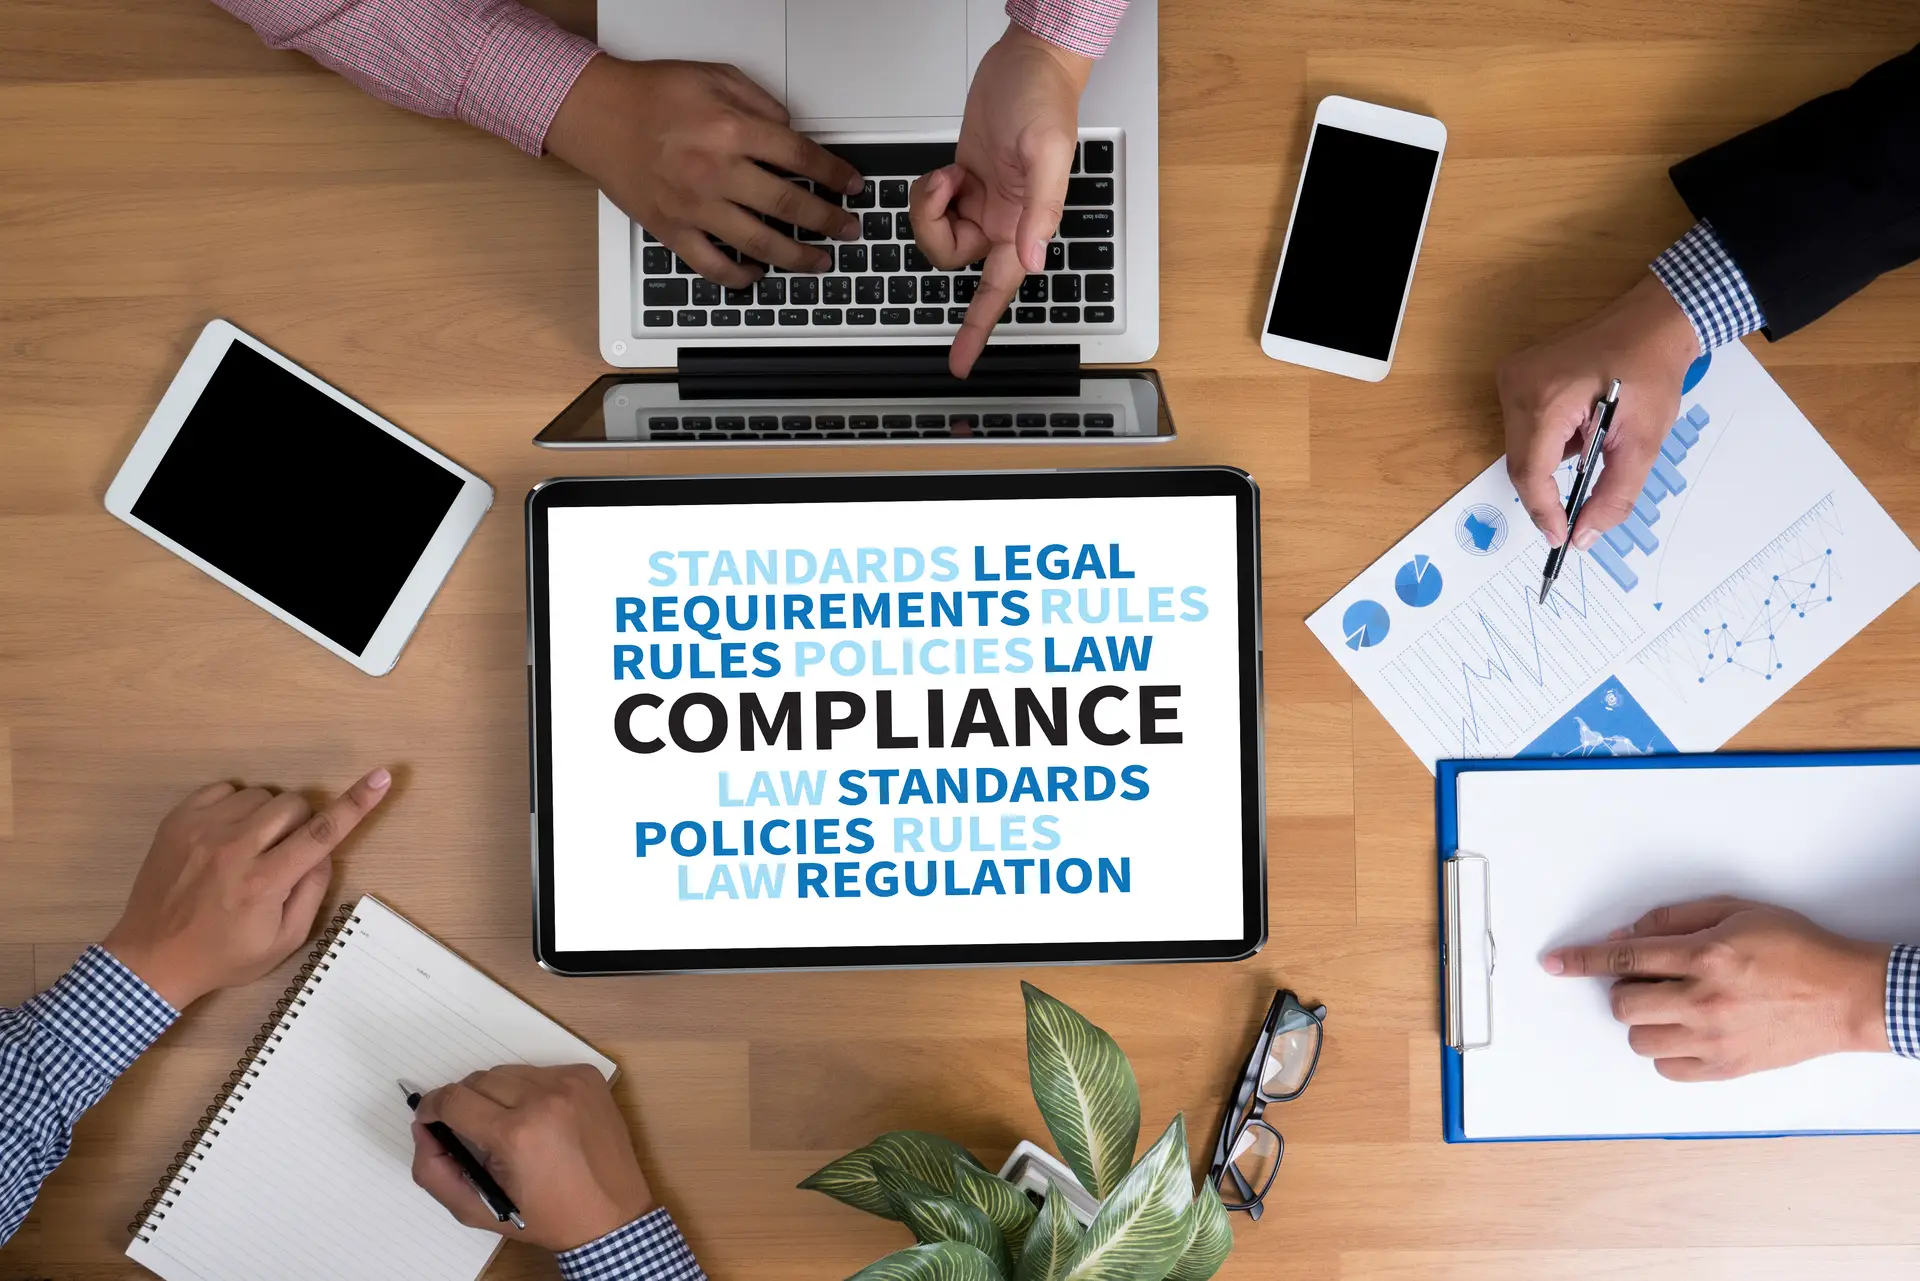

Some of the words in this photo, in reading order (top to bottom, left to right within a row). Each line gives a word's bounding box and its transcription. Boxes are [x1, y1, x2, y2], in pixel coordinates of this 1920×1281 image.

[1052, 246, 1061, 255] Q
[648, 545, 959, 588] STANDARDS
[974, 541, 1135, 581] LEGAL
[615, 589, 1030, 641] REQUIREMENTS
[1041, 586, 1209, 625] RULES
[613, 641, 781, 680] RULES
[795, 637, 1033, 677] POLICIES
[1044, 635, 1154, 675] LAW
[614, 685, 1183, 754] COMPLIANCE
[719, 770, 827, 807] LAW
[837, 764, 1150, 806] STANDARDS
[636, 817, 875, 858] POLICIES
[894, 815, 1061, 853] RULES
[678, 863, 786, 901] LAW
[798, 856, 1130, 898] REGULATION
